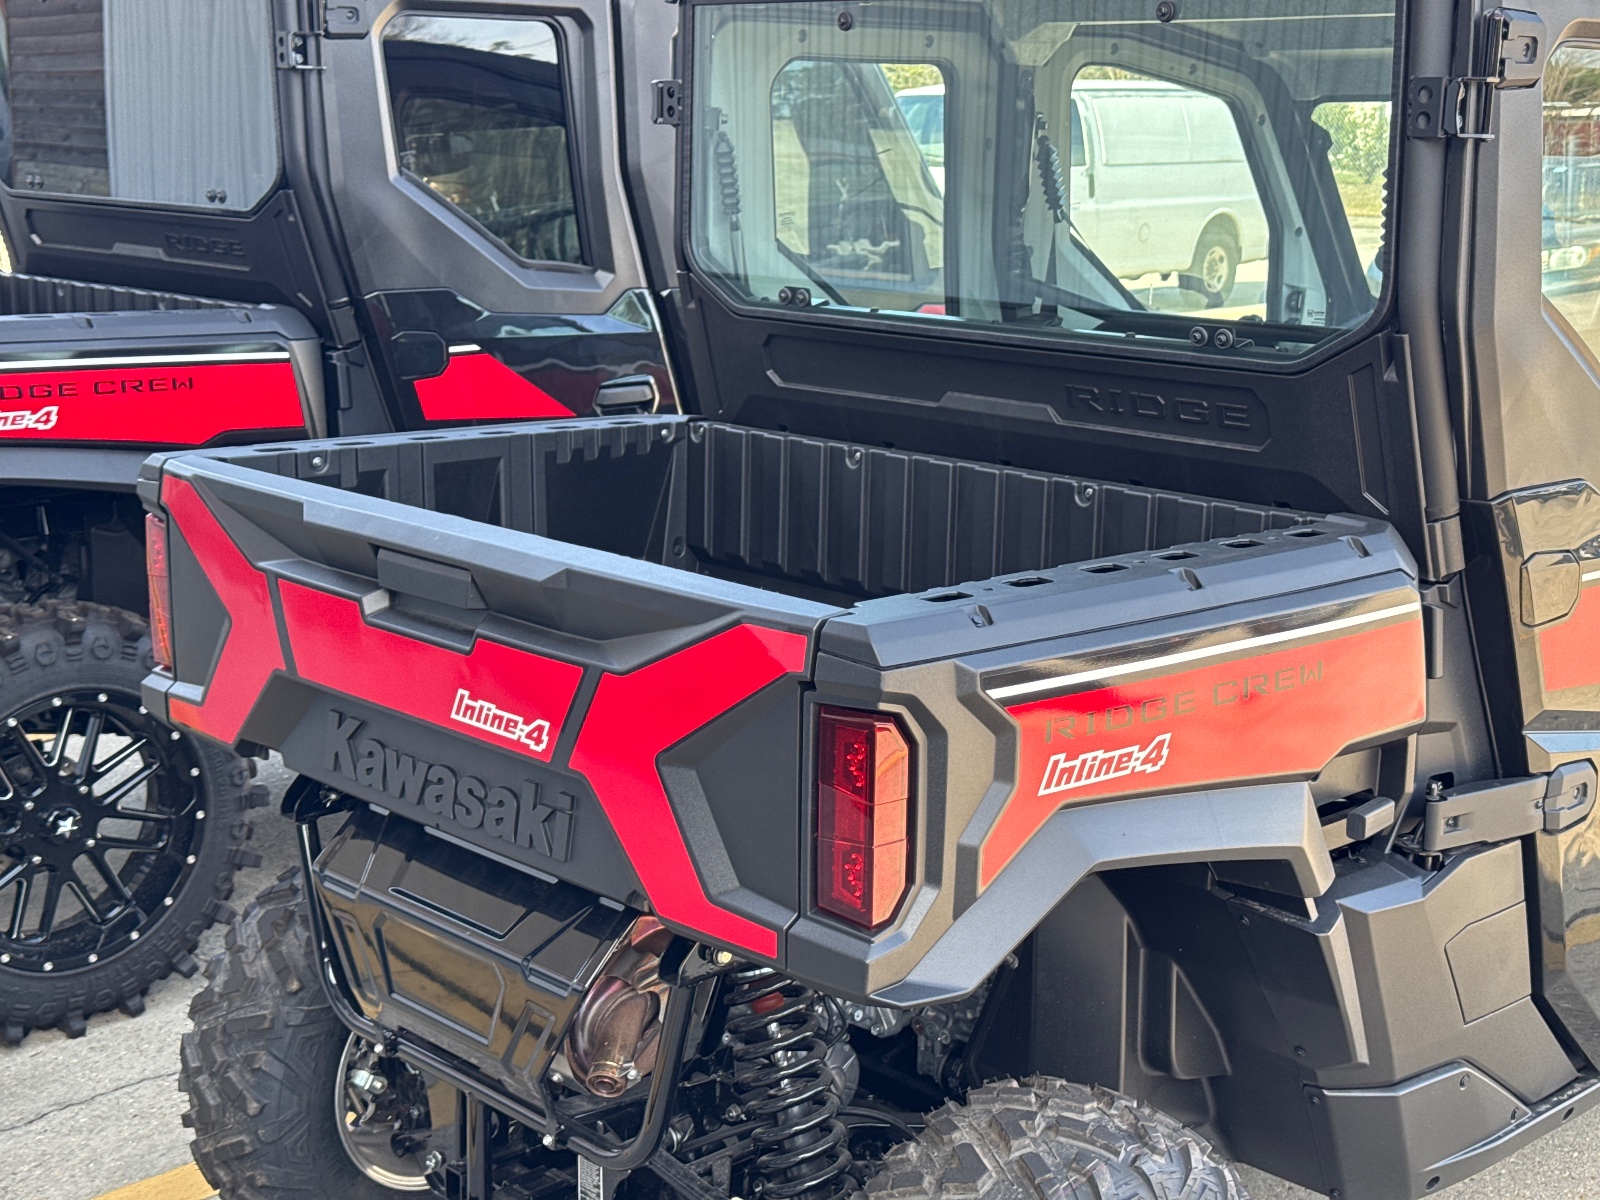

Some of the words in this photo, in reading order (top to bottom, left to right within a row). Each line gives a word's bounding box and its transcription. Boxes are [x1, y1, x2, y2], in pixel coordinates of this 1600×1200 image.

[163, 232, 245, 256] RIDGE
[94, 377, 193, 395] CREW
[1065, 383, 1251, 429] RIDGE
[450, 688, 550, 752] Inline-4
[1045, 690, 1196, 743] RIDGE
[1212, 660, 1323, 706] CREW
[323, 709, 576, 862] Kawasaki
[1037, 732, 1172, 796] Inline-4
